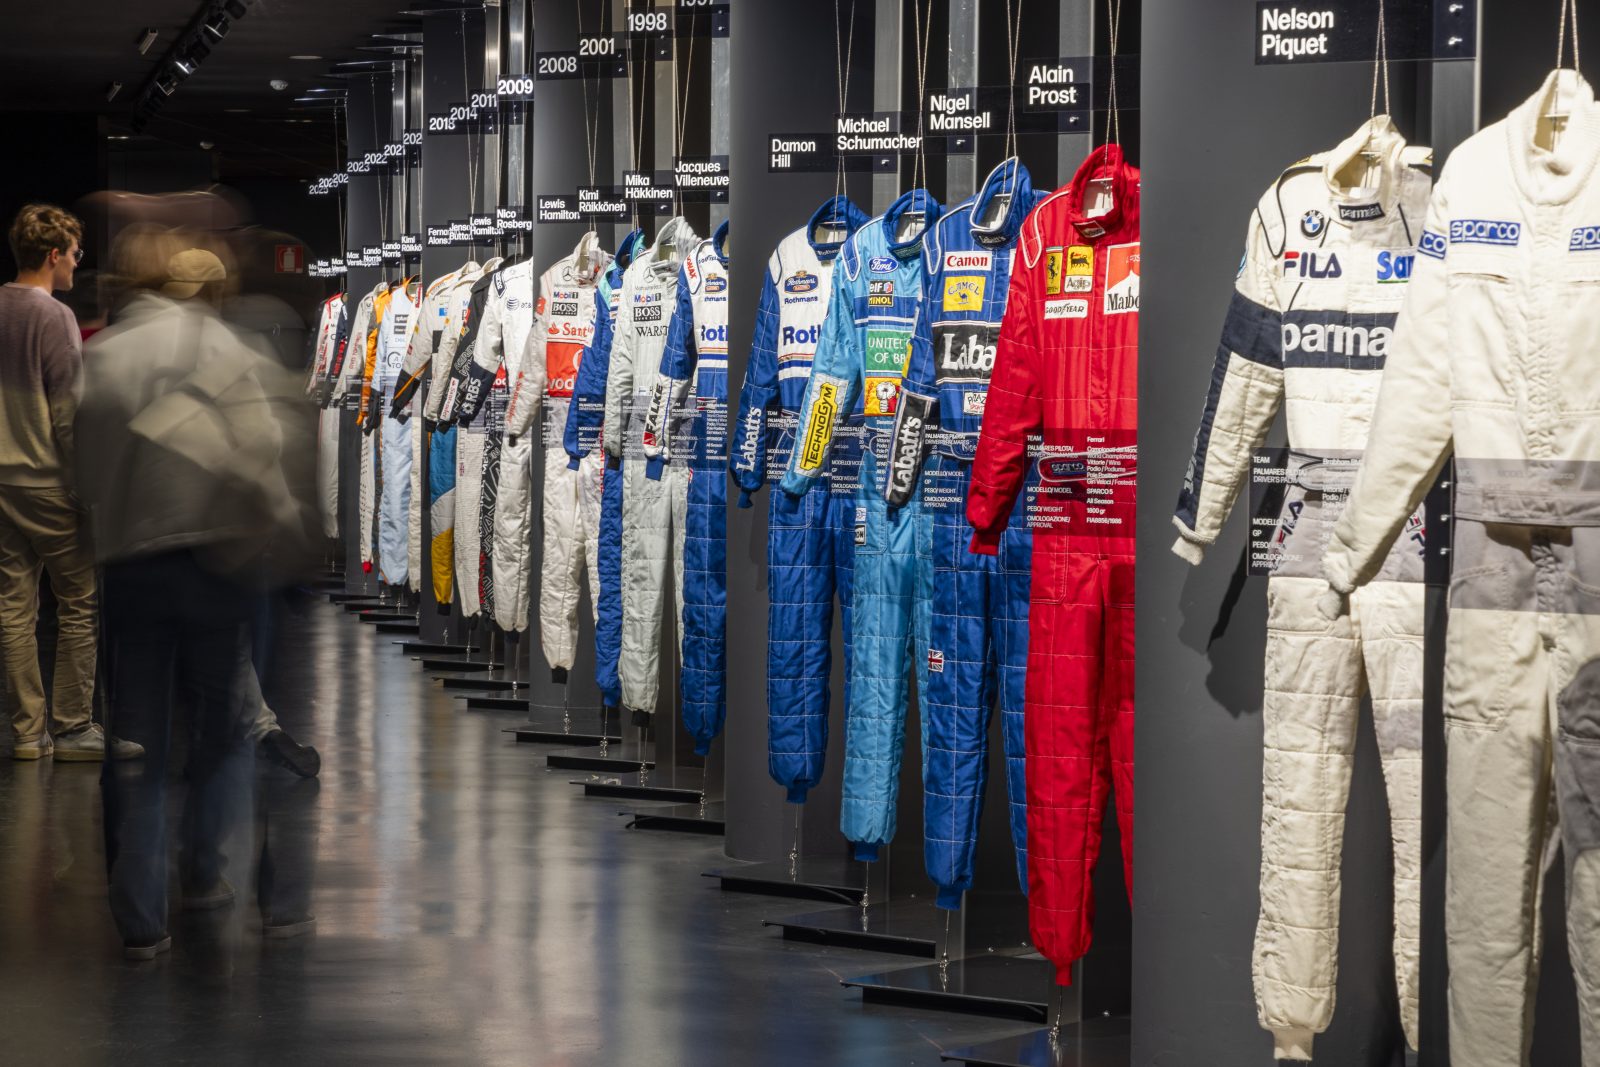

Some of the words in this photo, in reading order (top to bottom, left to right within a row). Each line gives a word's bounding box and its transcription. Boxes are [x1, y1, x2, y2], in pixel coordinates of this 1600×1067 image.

[627, 13, 667, 31] 1998
[1262, 8, 1334, 31] Nelson
[579, 38, 615, 55] 2001
[1262, 34, 1328, 59] Piquet
[538, 57, 577, 74] 2008
[1028, 65, 1074, 84] Alain
[497, 79, 534, 94] 2009
[471, 94, 497, 107] 2011
[1028, 87, 1077, 105] Prost
[930, 94, 970, 115] Nigel
[450, 107, 477, 120] 2014
[837, 117, 890, 133] Michael
[930, 112, 991, 130] Mansell
[771, 138, 816, 153] Damon
[837, 135, 922, 151] Schumacher
[365, 153, 388, 164] 2022
[771, 154, 791, 168] Hill
[347, 162, 370, 172] 2023
[675, 161, 721, 174] Jacques
[625, 175, 650, 186] Mika
[675, 174, 730, 187] Villeneuve
[579, 189, 599, 200] Kimi
[625, 188, 673, 199] Häkkinen
[540, 199, 566, 209] Lewis
[579, 202, 626, 213] Räikkönen
[497, 209, 517, 218] Nico
[540, 210, 580, 220] Hamilton
[470, 217, 491, 226] Lewis
[497, 219, 533, 230] Rosberg
[1451, 221, 1519, 241] sparco
[382, 242, 401, 250] Lando
[401, 235, 416, 244] Kimi
[363, 247, 382, 255] Lando
[870, 259, 893, 271] Ford
[947, 256, 988, 268] Canon
[1284, 251, 1342, 278] FILA
[948, 281, 980, 296] CAMEL
[784, 295, 818, 305] Rothmans
[552, 303, 577, 311] BOSS
[635, 307, 660, 316] BOSS
[874, 353, 889, 364] OF
[466, 377, 481, 402] RBS
[645, 383, 663, 434] FALKE
[736, 406, 762, 472] Labatt's
